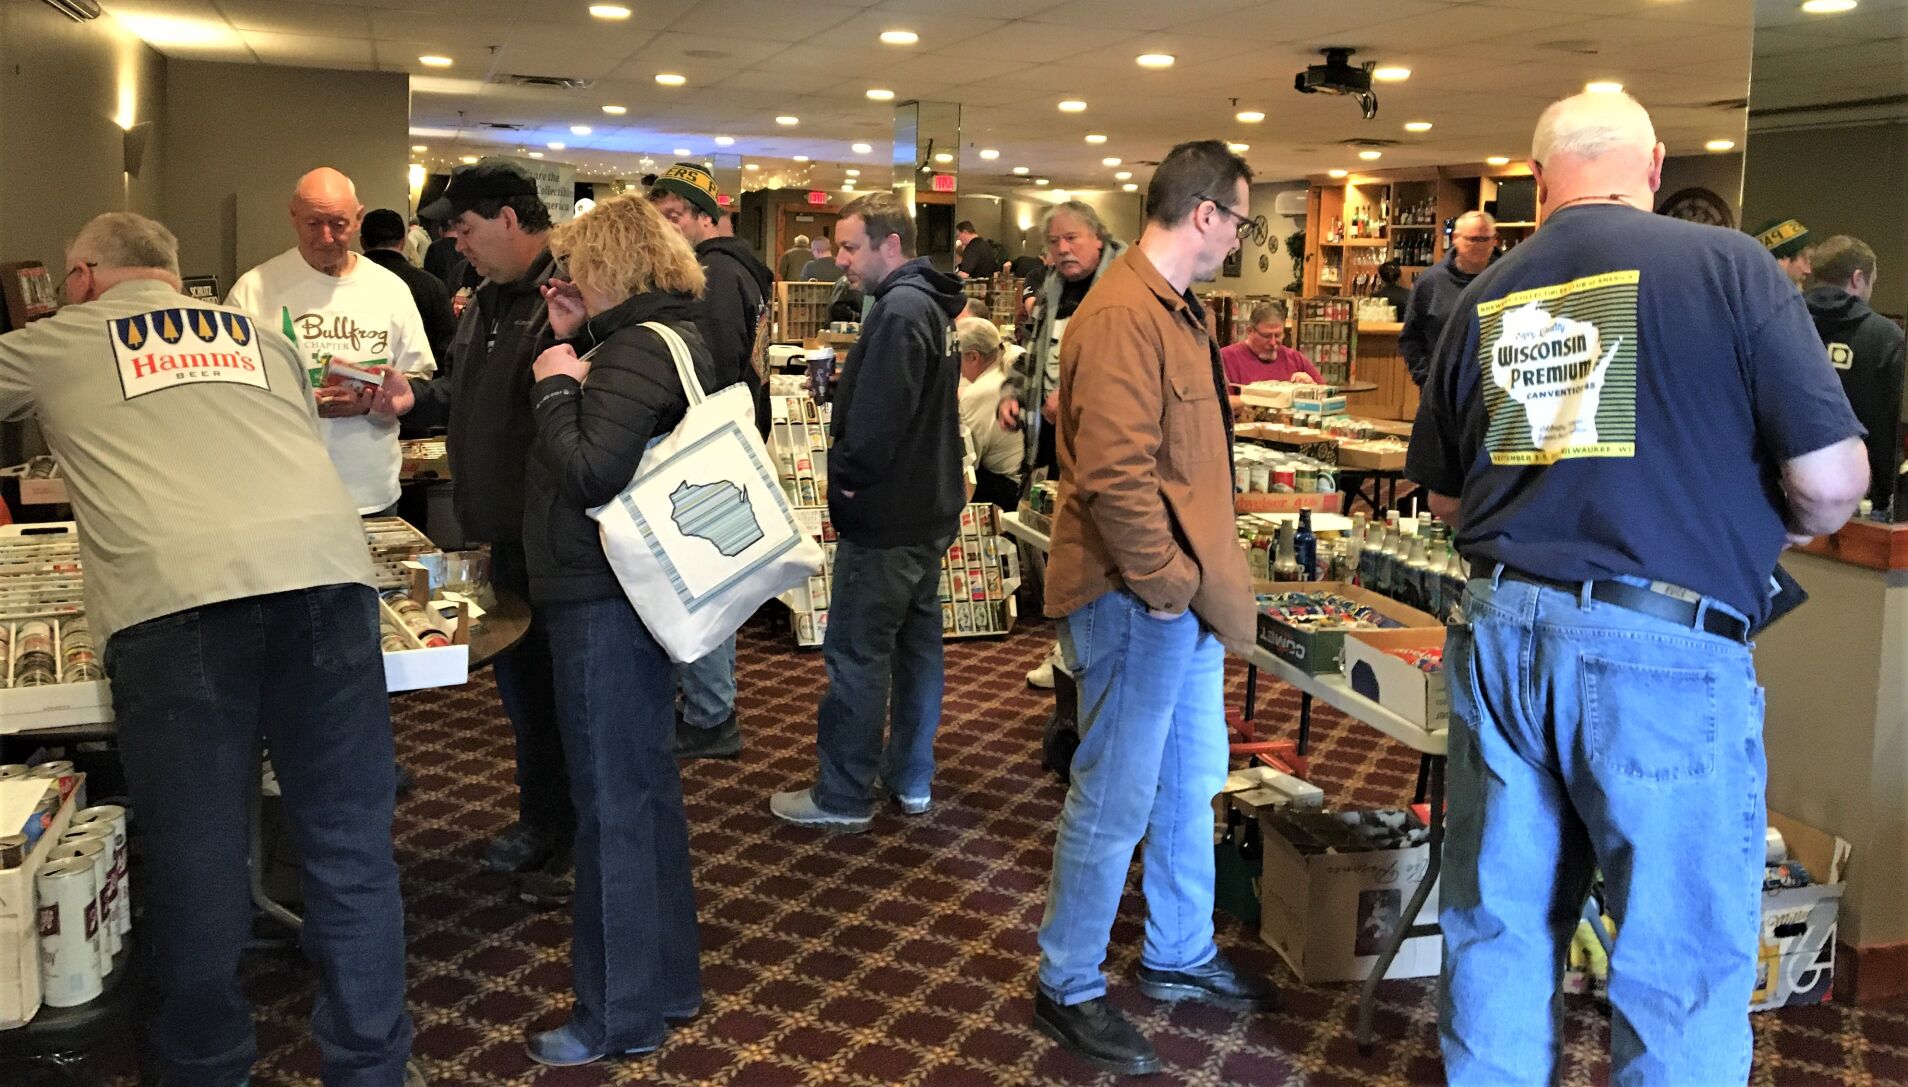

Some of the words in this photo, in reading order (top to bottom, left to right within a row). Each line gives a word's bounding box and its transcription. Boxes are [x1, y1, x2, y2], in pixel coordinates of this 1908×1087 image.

[548, 172, 560, 183] the
[293, 313, 388, 354] Bullfrog
[304, 341, 350, 351] CHAPTER
[131, 350, 256, 379] Hamm's
[176, 370, 221, 380] BEER
[1511, 360, 1592, 389] PREMIUM
[1236, 496, 1288, 509] dweiser
[1259, 626, 1306, 660] COMET
